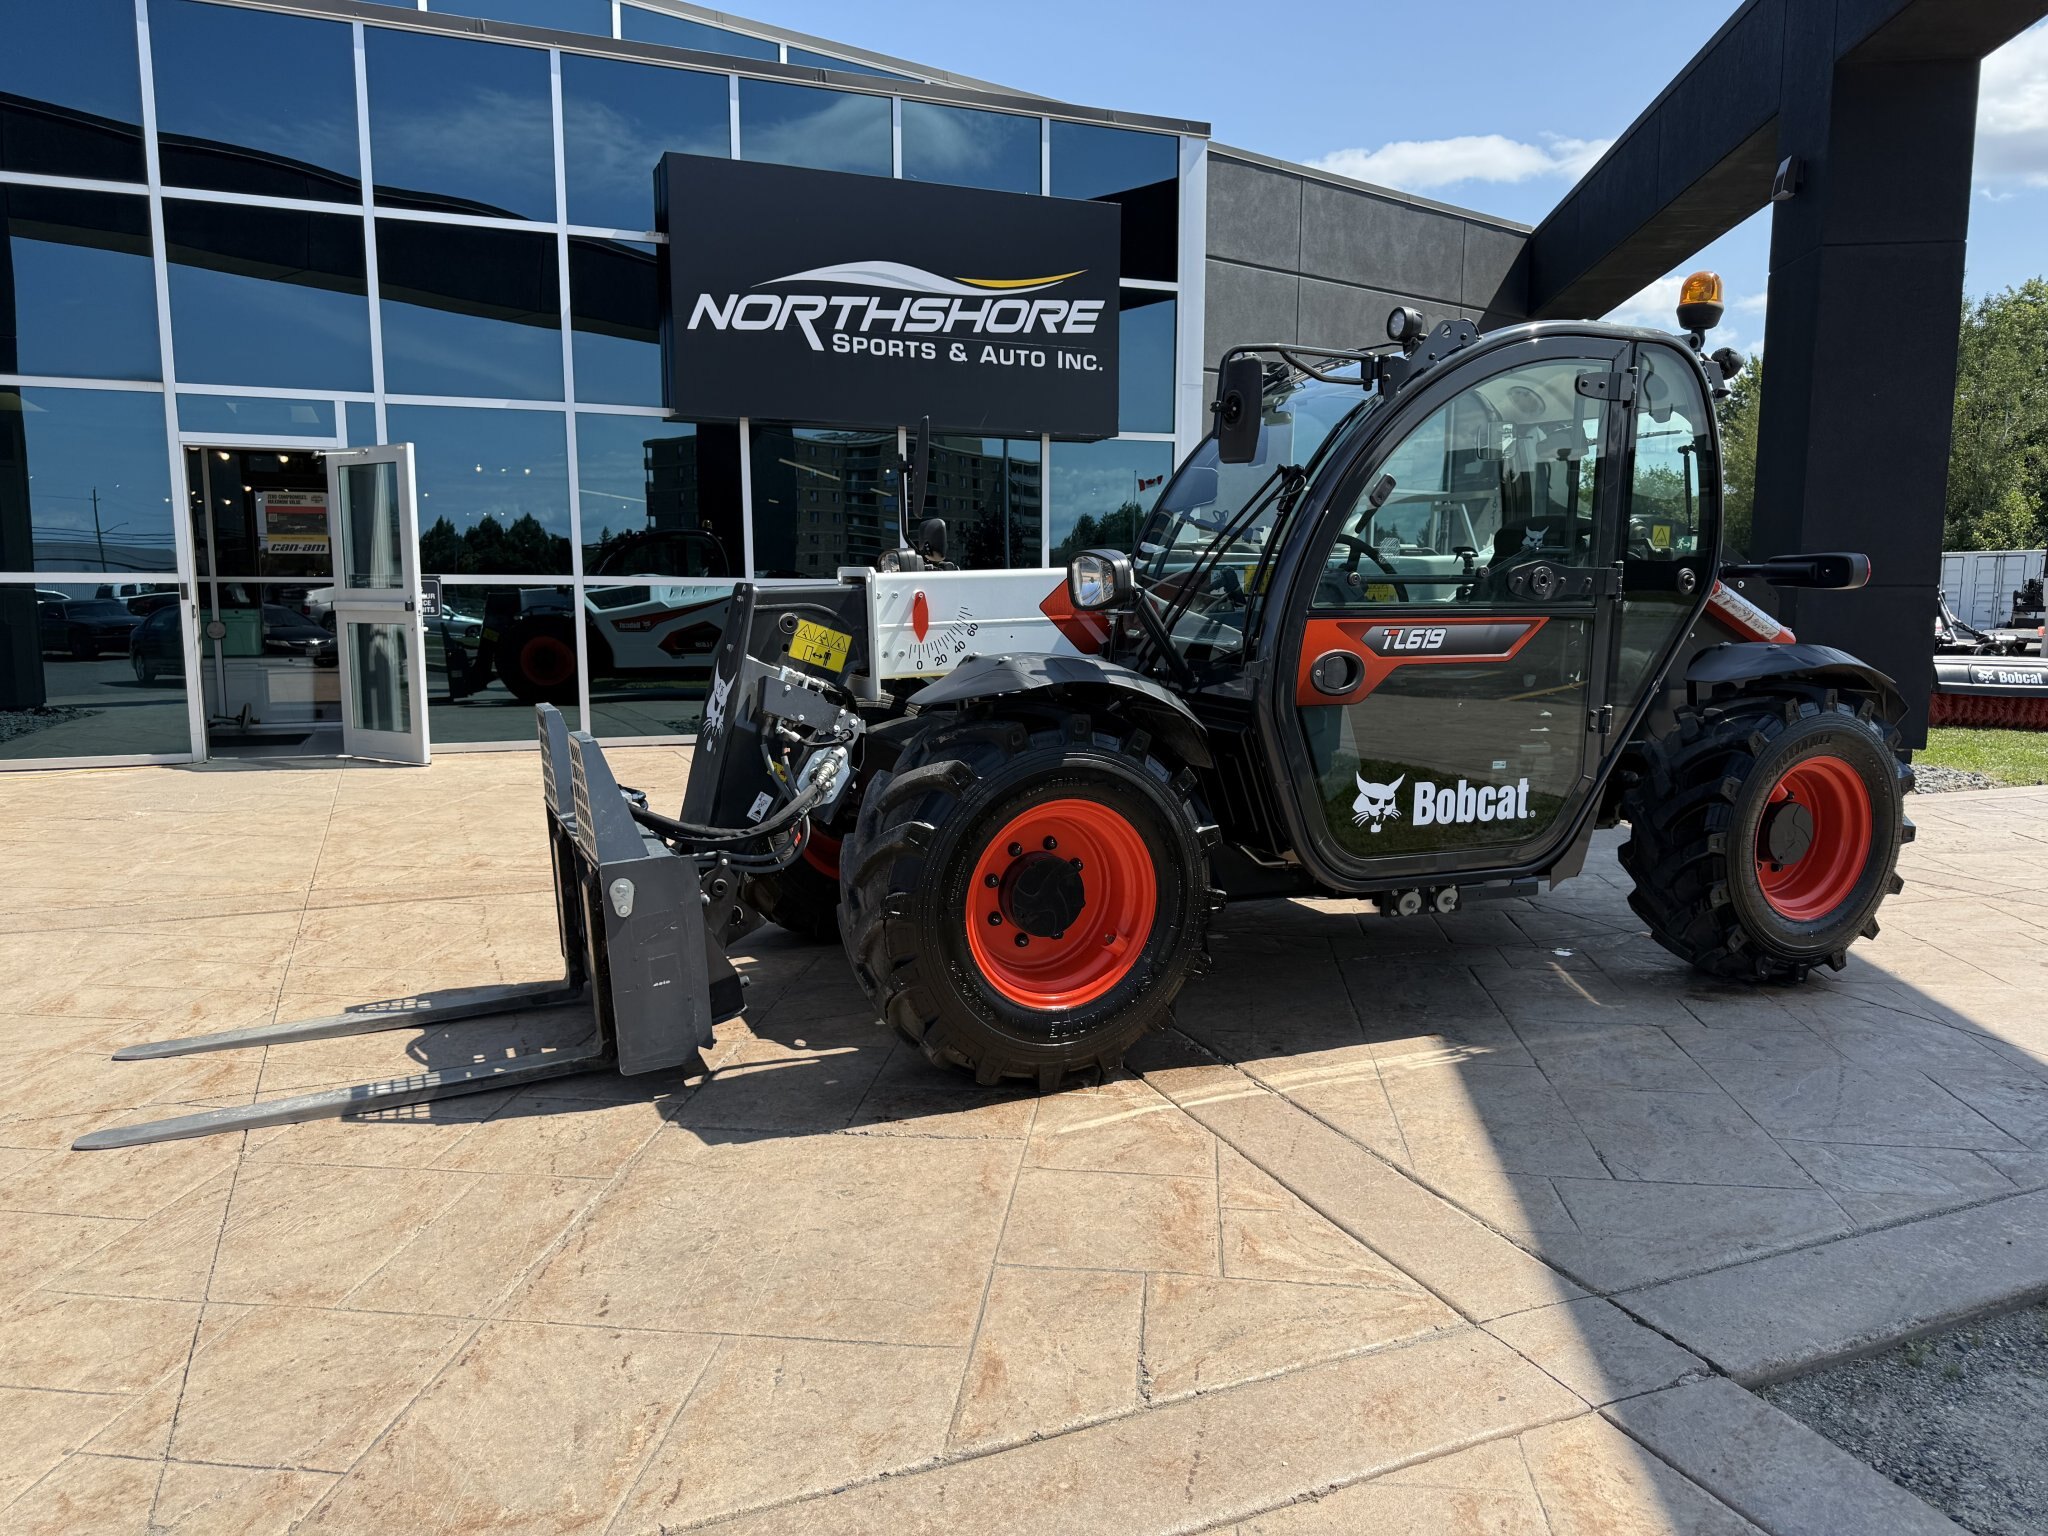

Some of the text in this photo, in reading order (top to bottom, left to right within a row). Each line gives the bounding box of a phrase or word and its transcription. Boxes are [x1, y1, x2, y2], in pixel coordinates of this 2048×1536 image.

[687, 293, 1105, 351] NORTHSHORE
[949, 343, 968, 362] &
[967, 623, 978, 636] 60
[1383, 628, 1447, 650] TL619
[954, 641, 966, 653] 40
[917, 661, 923, 670] 0
[935, 654, 947, 666] 20
[1998, 671, 2043, 685] Bobcat
[1412, 777, 1530, 826] Bobcat
